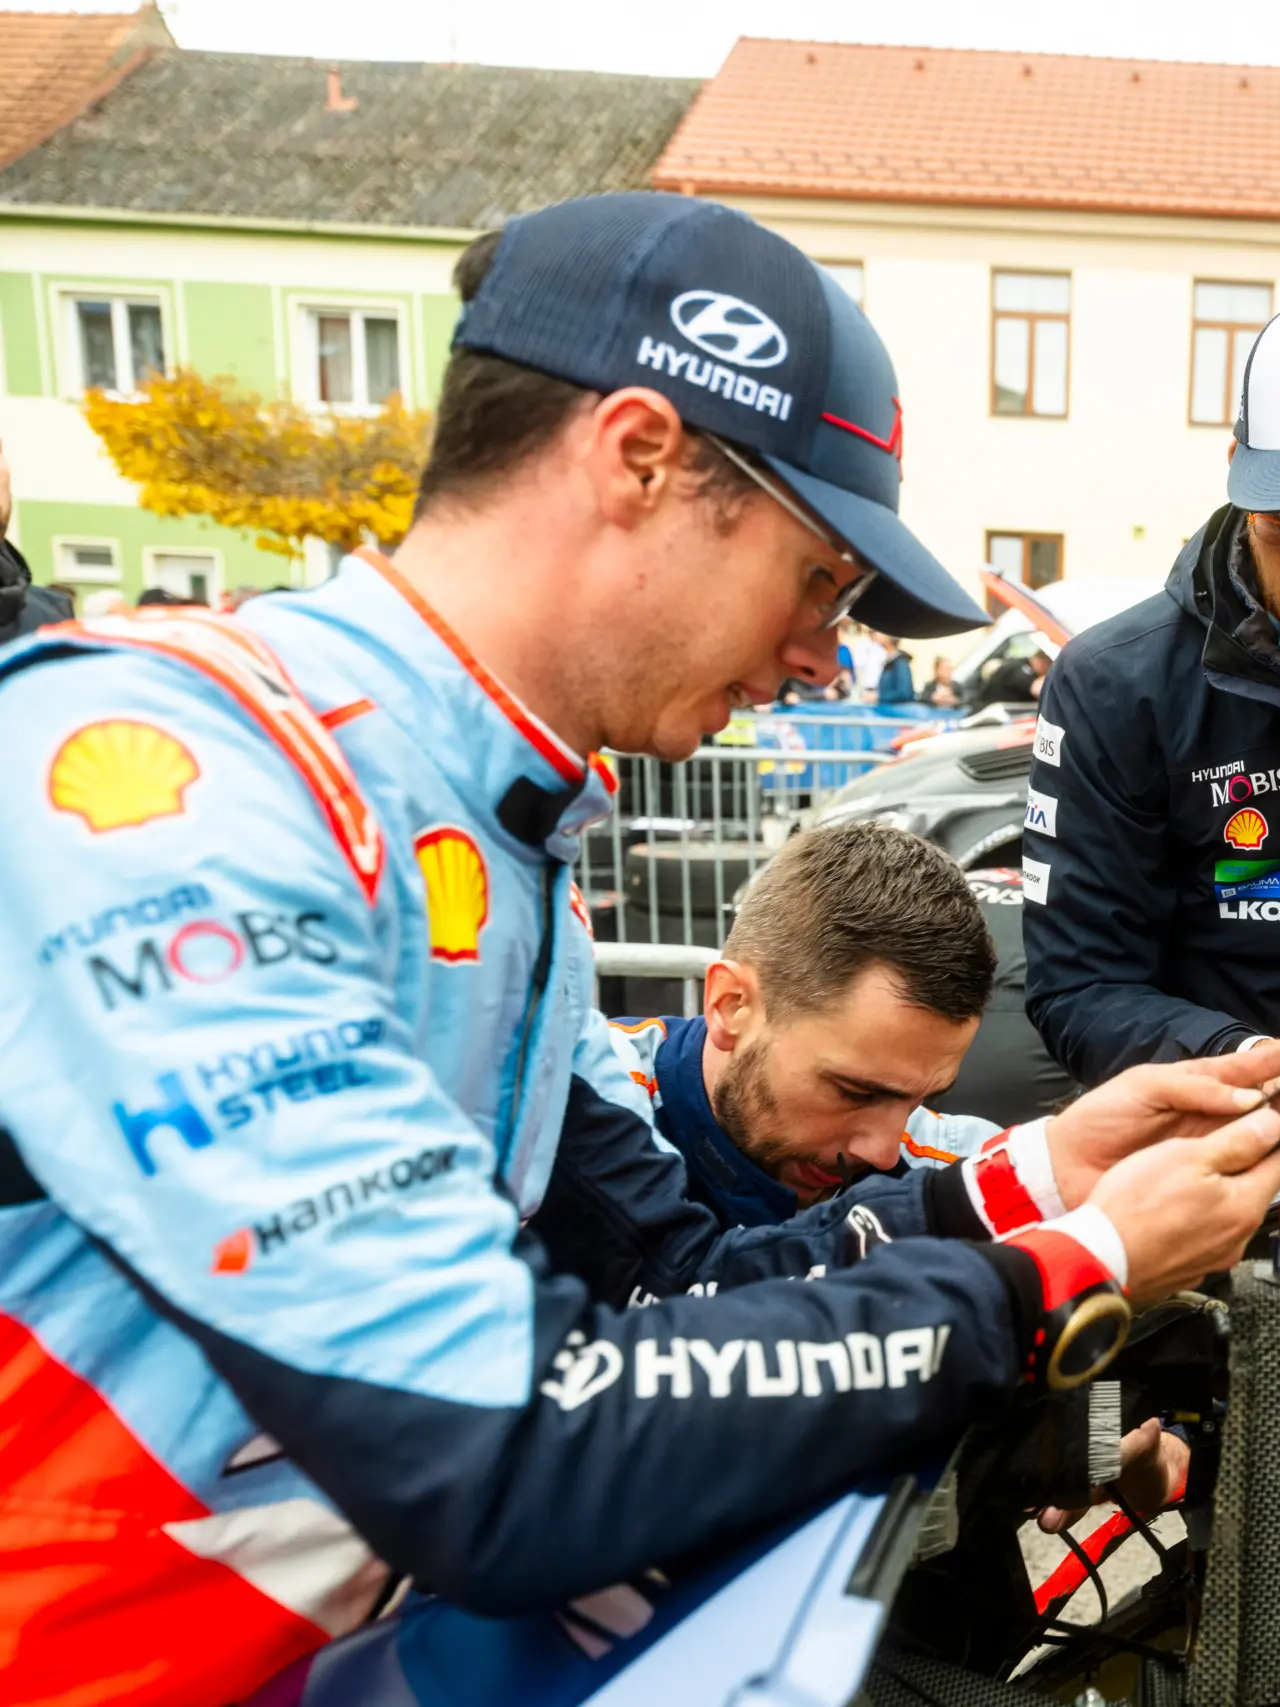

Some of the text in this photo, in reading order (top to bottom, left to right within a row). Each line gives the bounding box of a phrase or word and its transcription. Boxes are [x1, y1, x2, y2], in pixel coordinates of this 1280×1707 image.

[638, 335, 793, 421] HYUNDAI
[1191, 760, 1245, 782] HYUNDAI
[85, 909, 340, 1011] MOBS
[216, 1060, 373, 1130] STEEL
[635, 1325, 951, 1399] HYUNDAI
